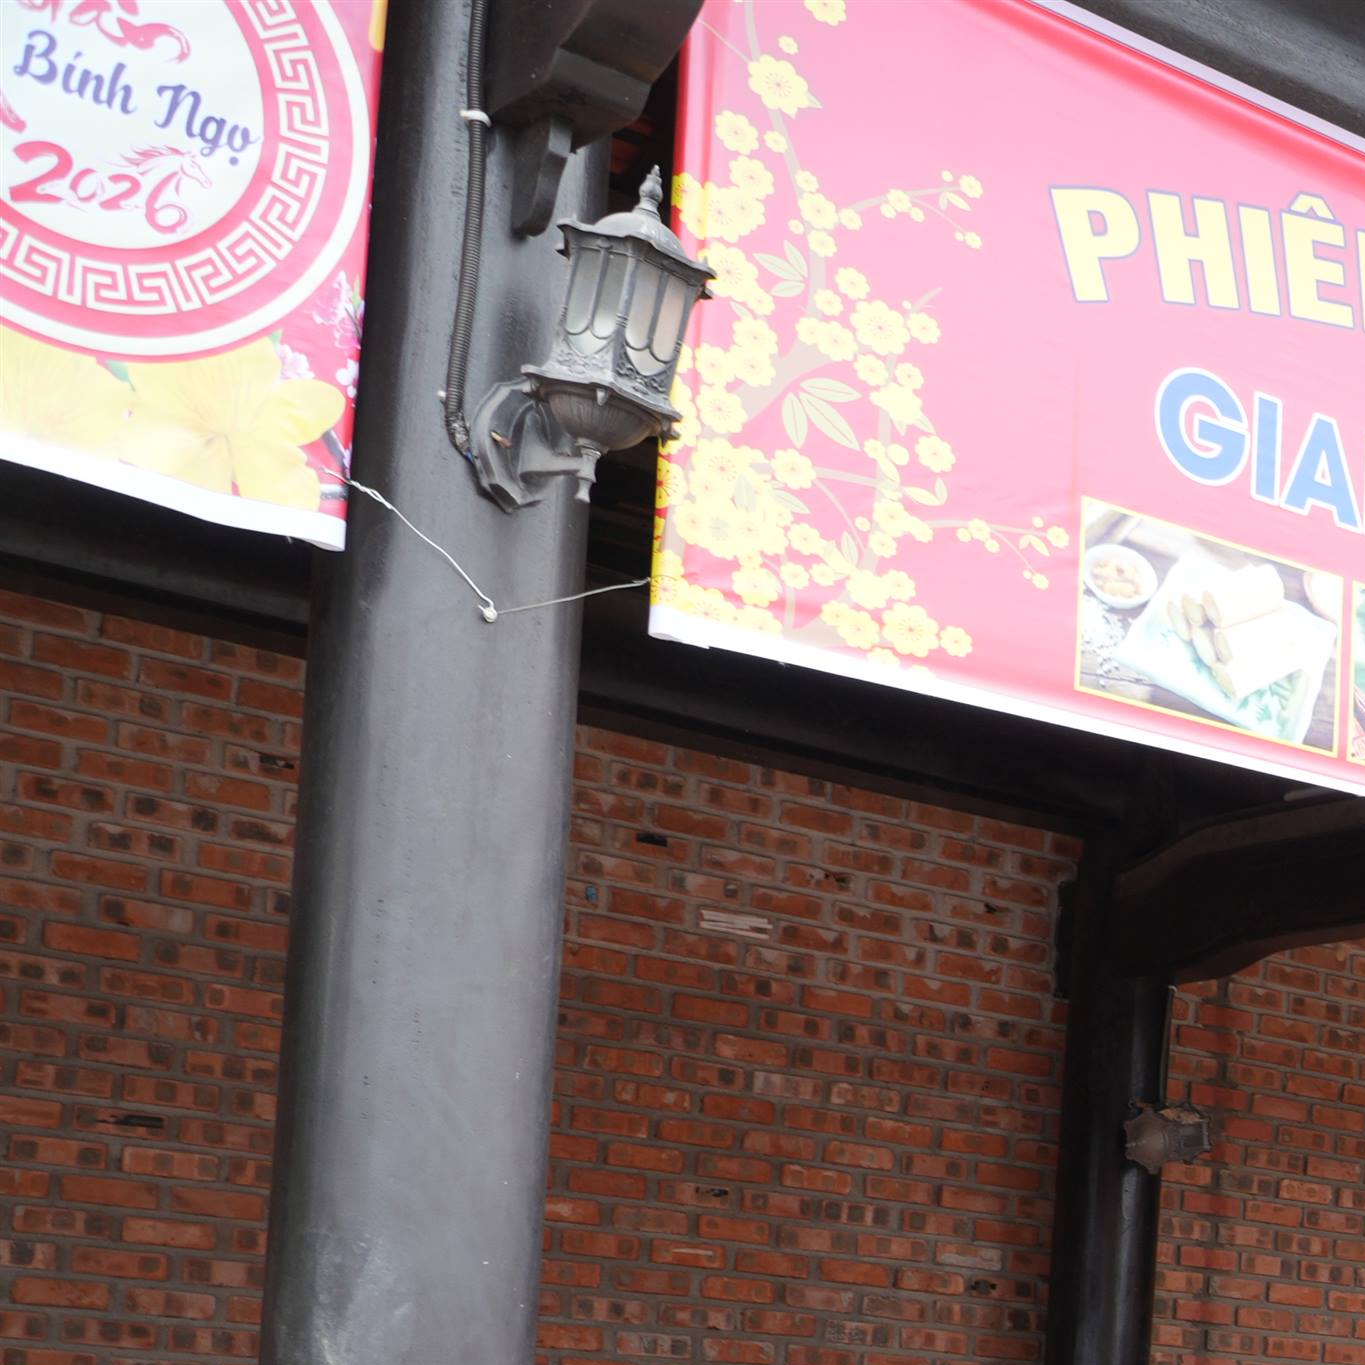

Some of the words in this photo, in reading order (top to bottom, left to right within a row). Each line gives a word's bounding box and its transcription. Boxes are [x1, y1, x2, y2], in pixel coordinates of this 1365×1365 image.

[13, 30, 138, 115] Bính
[153, 84, 260, 166] Ngọ
[9, 141, 188, 234] 2026
